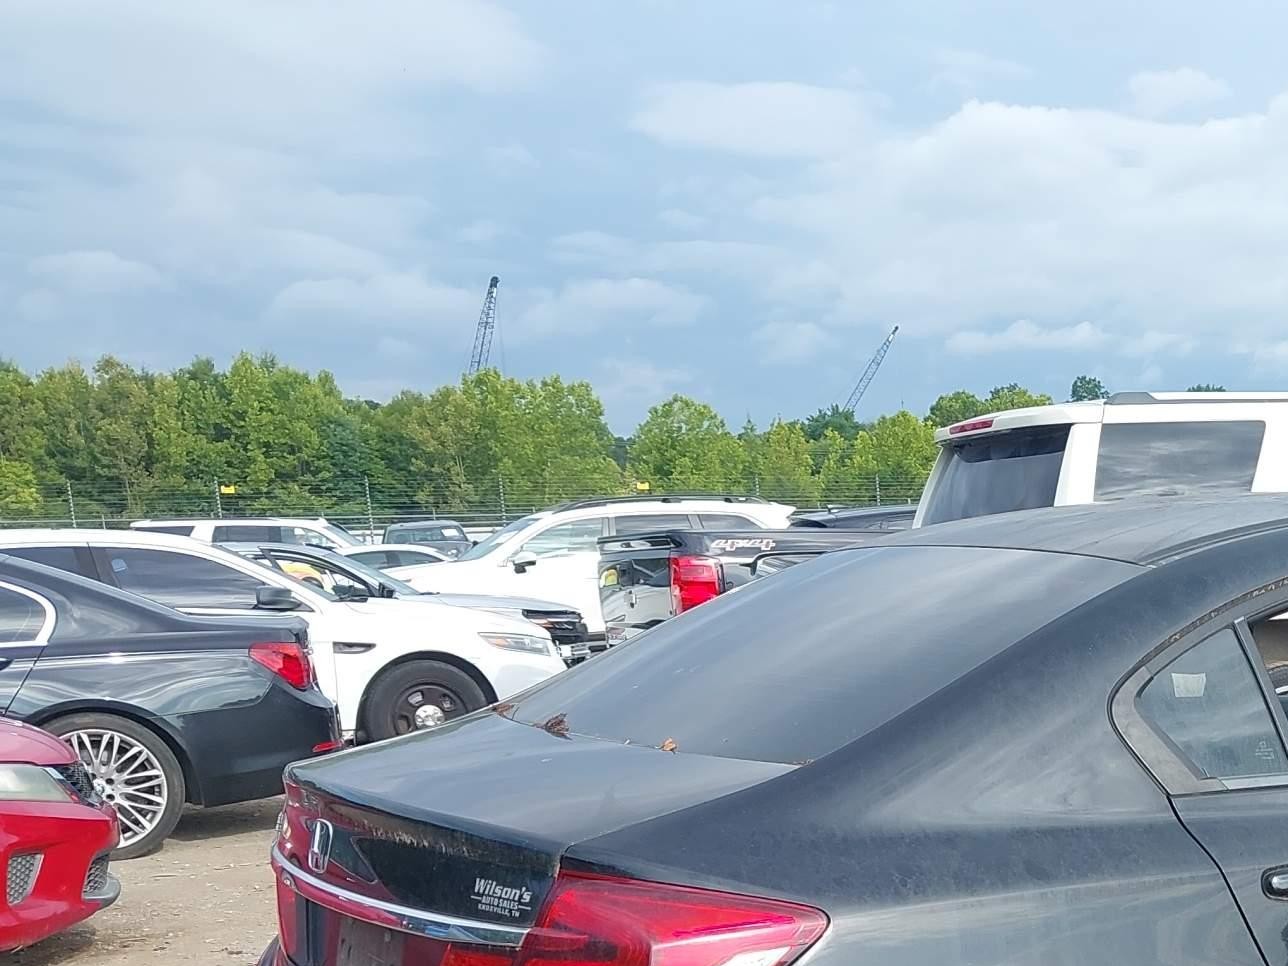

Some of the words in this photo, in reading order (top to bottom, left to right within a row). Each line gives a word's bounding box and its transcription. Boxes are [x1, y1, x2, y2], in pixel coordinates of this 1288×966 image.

[474, 878, 533, 903] Wilson's
[481, 895, 498, 906] AUTO
[499, 899, 519, 911] SALES
[511, 910, 520, 918] TN
